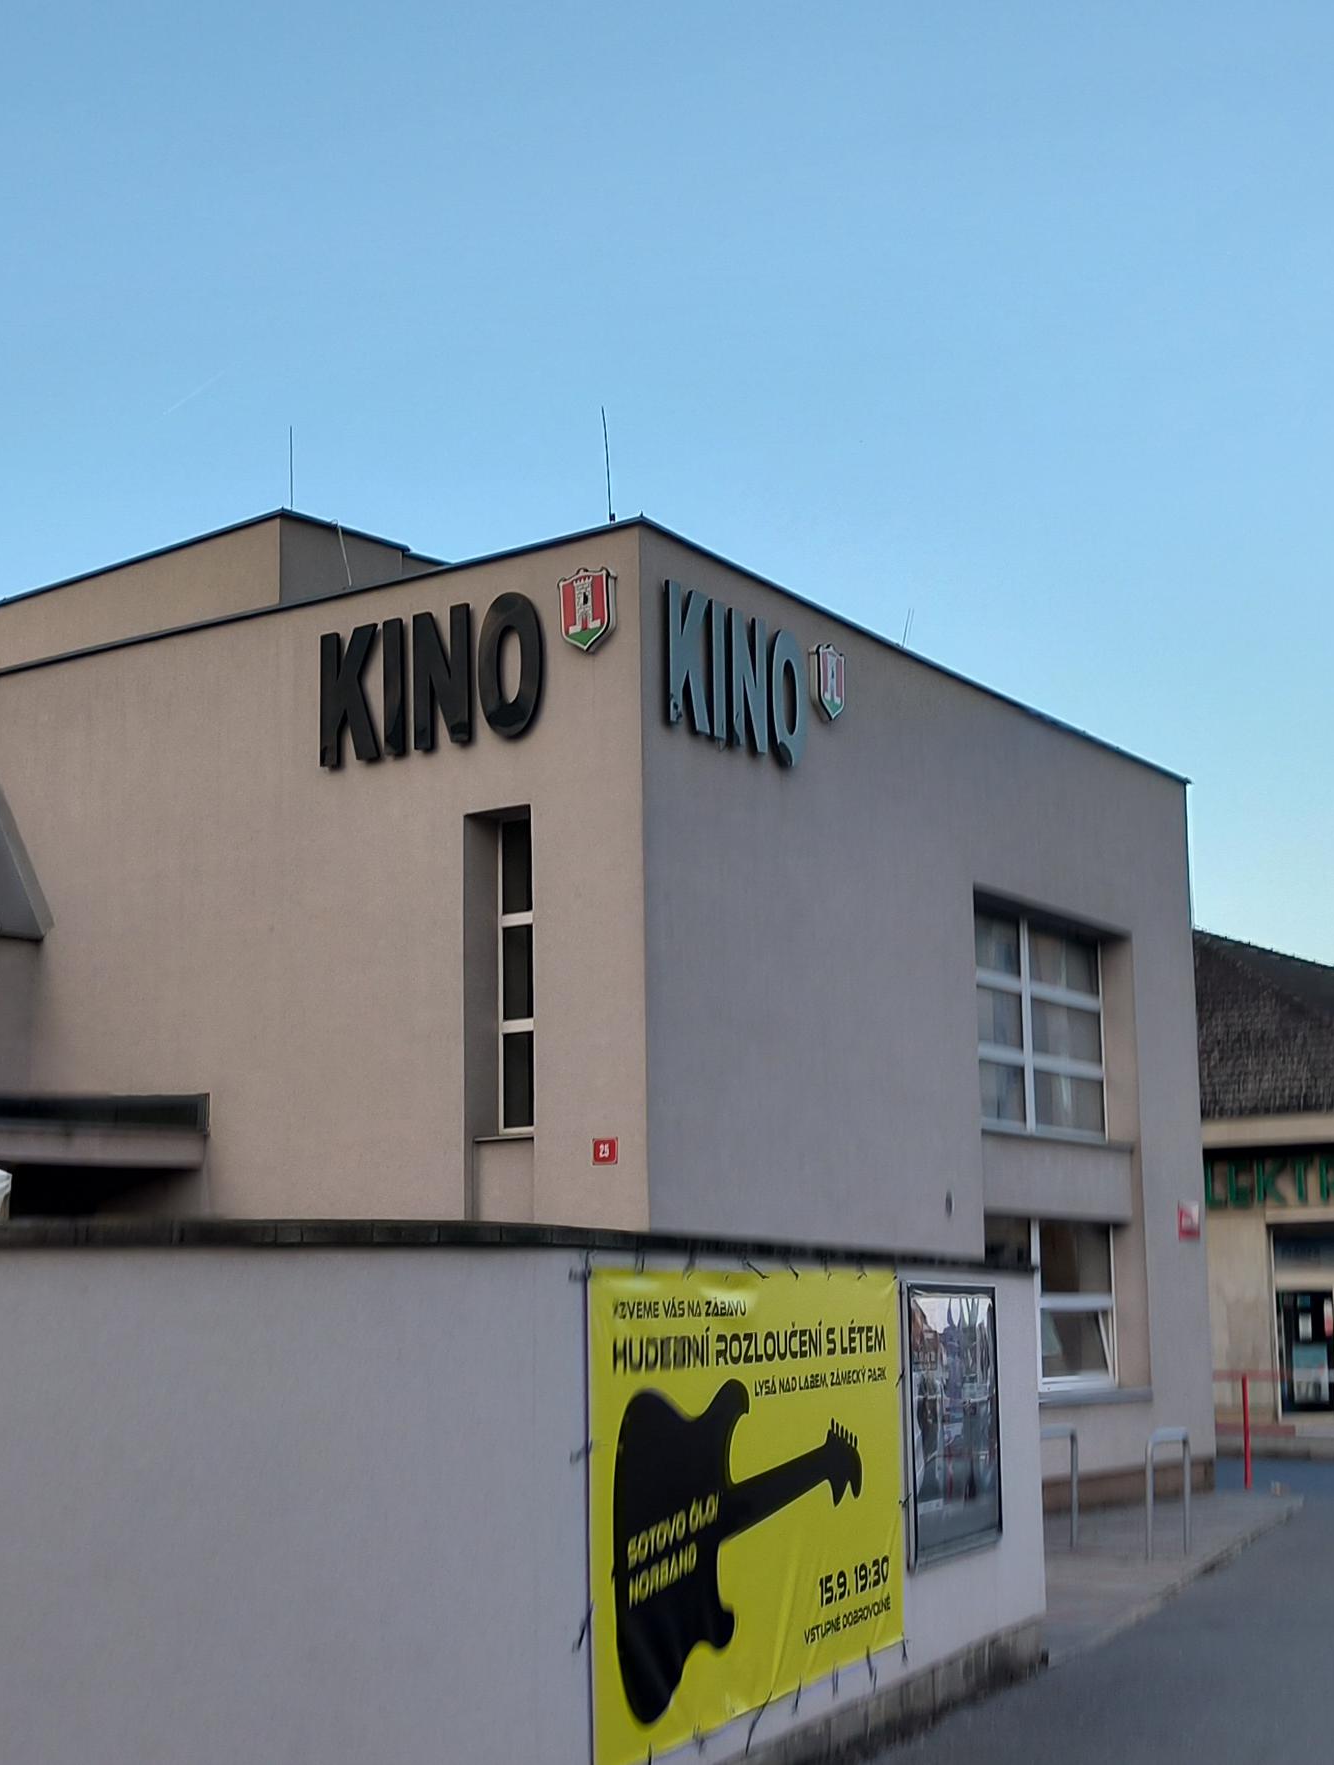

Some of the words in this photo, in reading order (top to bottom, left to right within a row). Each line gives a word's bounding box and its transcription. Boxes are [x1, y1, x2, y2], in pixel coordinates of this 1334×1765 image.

[320, 591, 545, 769] KINO
[663, 580, 808, 767] KINO
[663, 1296, 685, 1318] VÁS
[688, 1300, 702, 1317] NA
[704, 1297, 747, 1317] ZÁBAVU
[715, 1320, 822, 1367] ROZLOUČENÍ
[826, 1327, 836, 1356] S
[840, 1319, 886, 1355] LÉTEM
[754, 1375, 777, 1397] LYSÁ
[778, 1376, 798, 1395] NAD
[830, 1367, 867, 1388] ZÁMECKÝ
[867, 1366, 887, 1383] PARK
[819, 1570, 850, 1608] 15.9.
[854, 1554, 889, 1594] 19:30
[804, 1612, 841, 1645] VSTUPNÉ
